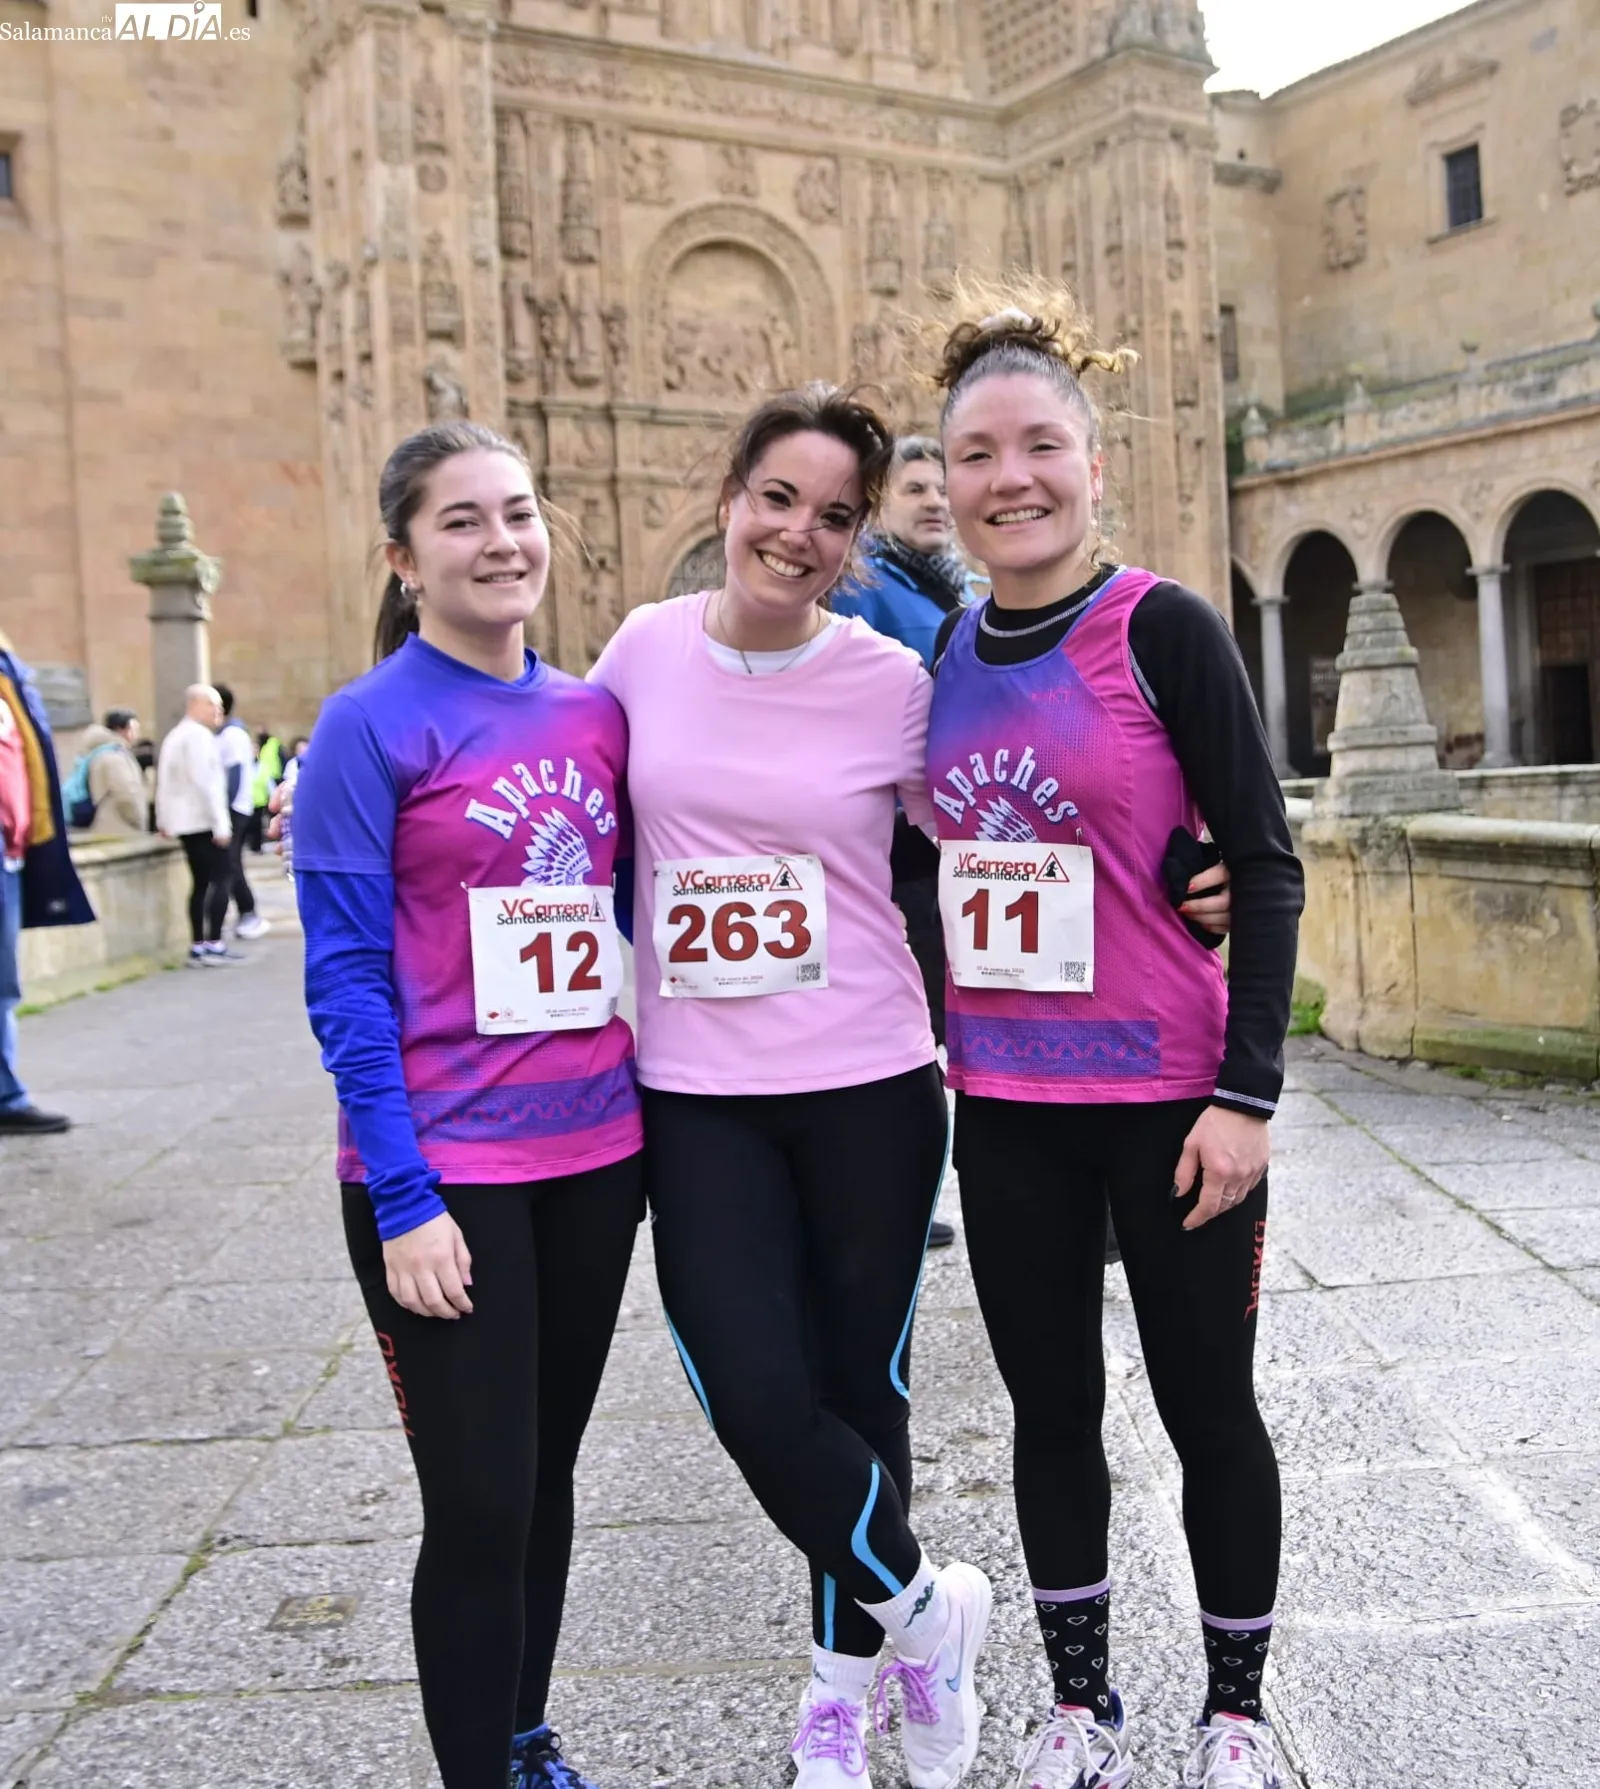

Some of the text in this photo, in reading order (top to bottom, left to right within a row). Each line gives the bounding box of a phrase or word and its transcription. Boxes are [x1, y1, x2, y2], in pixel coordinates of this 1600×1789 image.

[464, 757, 617, 842] Apaches
[933, 745, 1079, 825] Apaches
[667, 899, 812, 963] 263
[962, 888, 1039, 954] 11
[519, 930, 602, 994] 12
